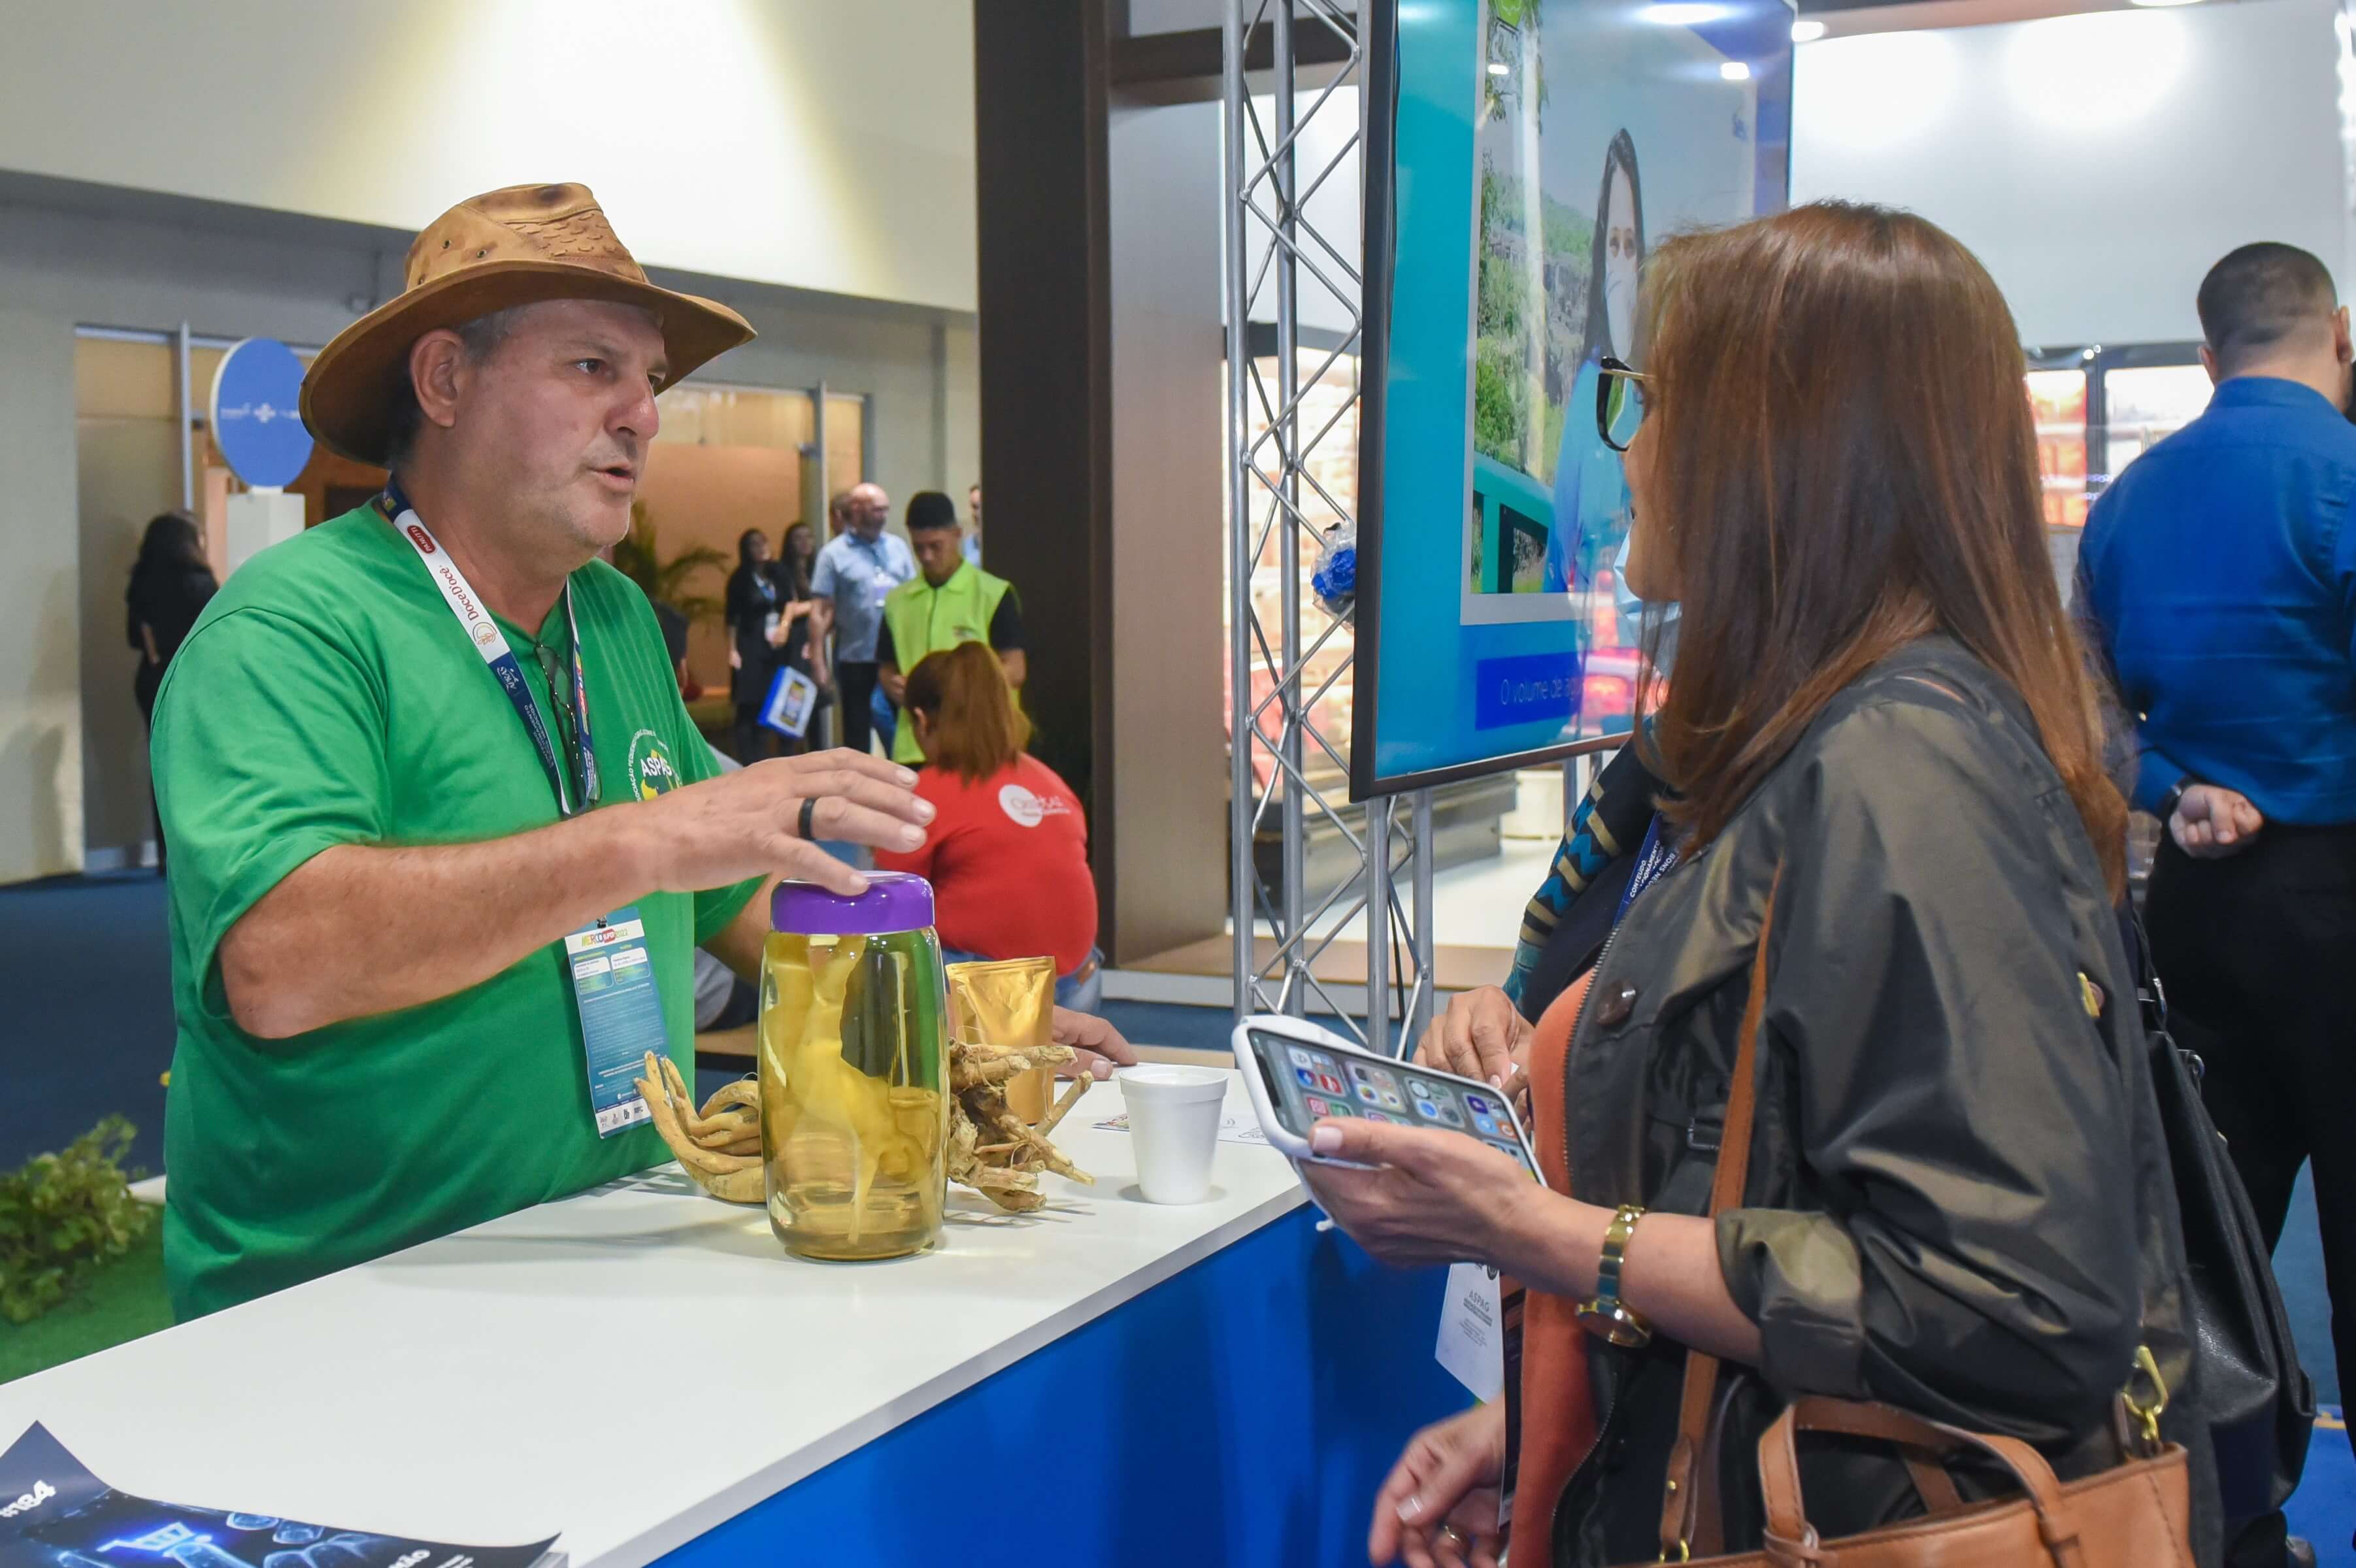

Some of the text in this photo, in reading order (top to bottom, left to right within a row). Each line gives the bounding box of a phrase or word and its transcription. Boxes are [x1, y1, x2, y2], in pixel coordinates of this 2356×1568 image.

[411, 526, 433, 552] PANUTTI
[1501, 679, 1510, 705] O
[1513, 677, 1548, 703] volume
